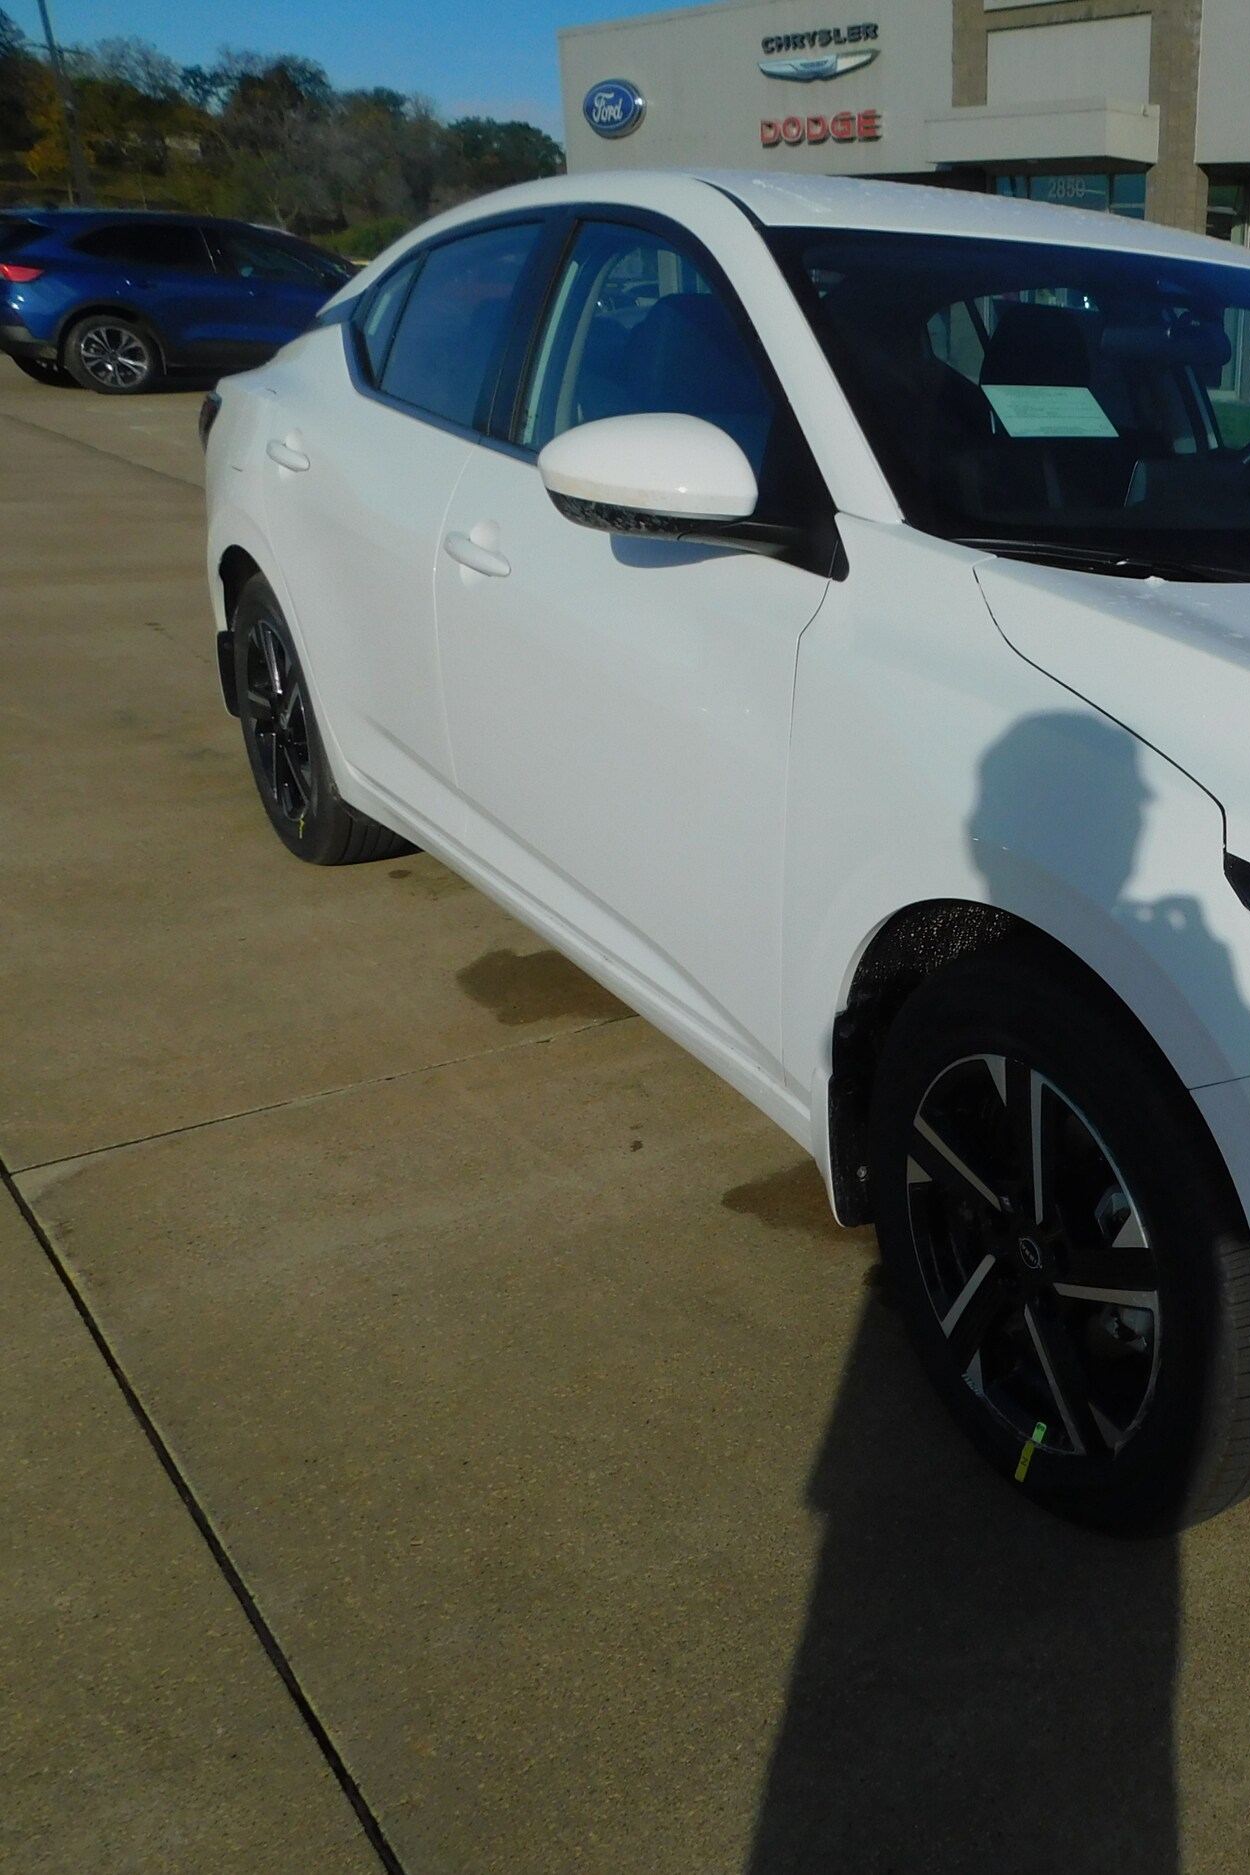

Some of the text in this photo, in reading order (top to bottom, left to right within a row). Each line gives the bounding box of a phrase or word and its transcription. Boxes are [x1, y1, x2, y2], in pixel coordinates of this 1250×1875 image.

[761, 22, 879, 55] CHRYSLER
[592, 91, 624, 123] Ford
[760, 109, 881, 147] DODGE
[1048, 177, 1086, 198] 2850
